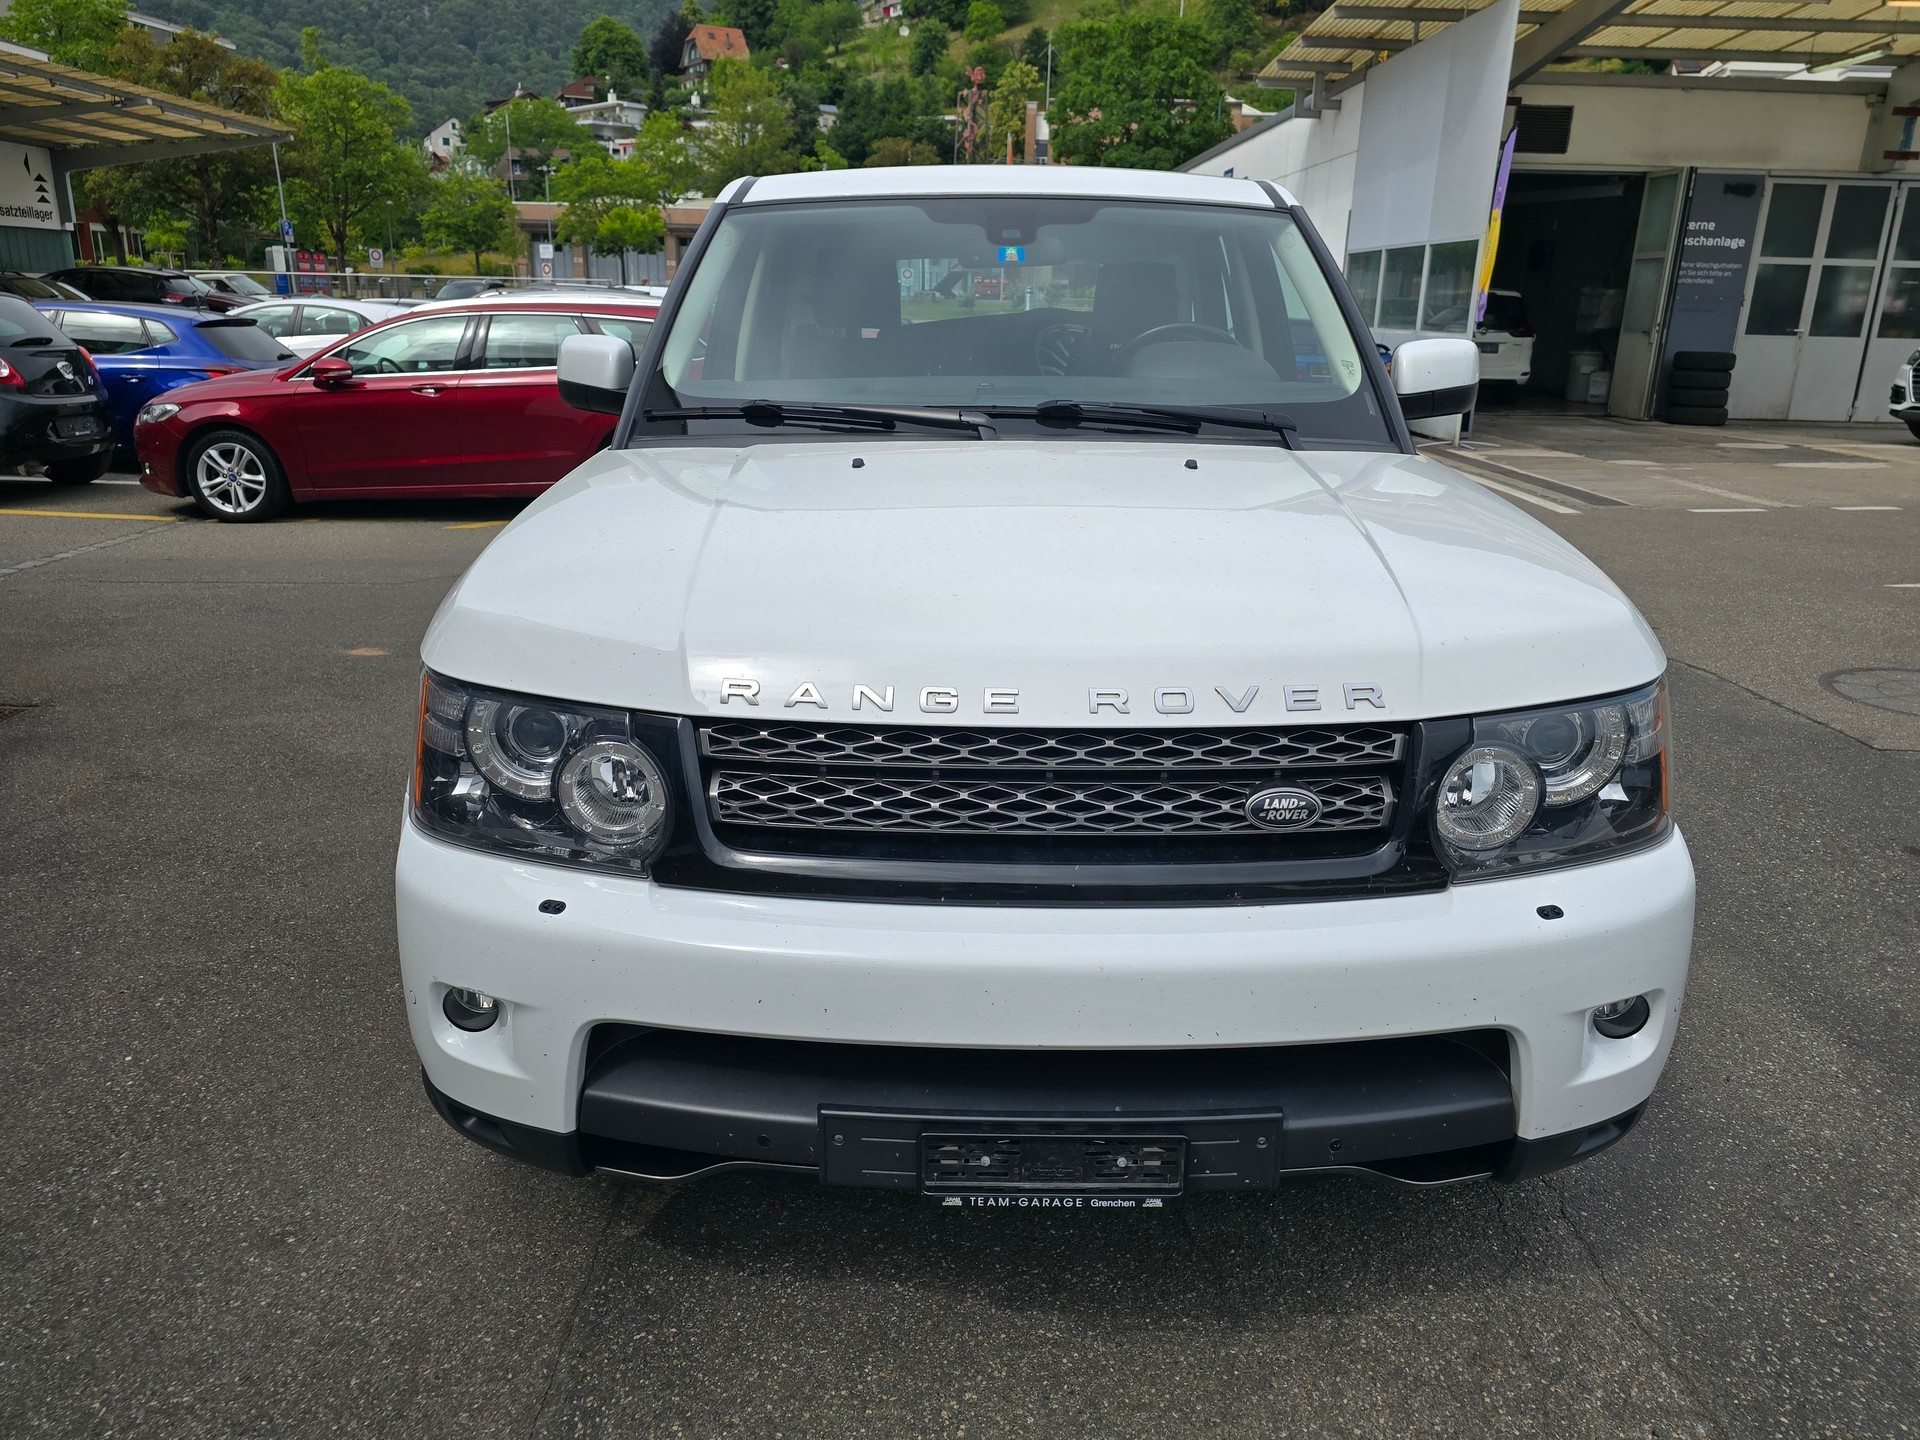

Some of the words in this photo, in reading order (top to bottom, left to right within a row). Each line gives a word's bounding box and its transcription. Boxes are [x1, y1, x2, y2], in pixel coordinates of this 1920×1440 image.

[0, 205, 53, 222] satzteillager
[720, 677, 1019, 714] RANGE
[1088, 681, 1386, 714] ROVER
[1263, 798, 1299, 810] LAND
[1266, 808, 1309, 820] ROVER
[969, 1197, 1083, 1207] TEAM-GARAGE
[1090, 1199, 1136, 1208] Grenchen
